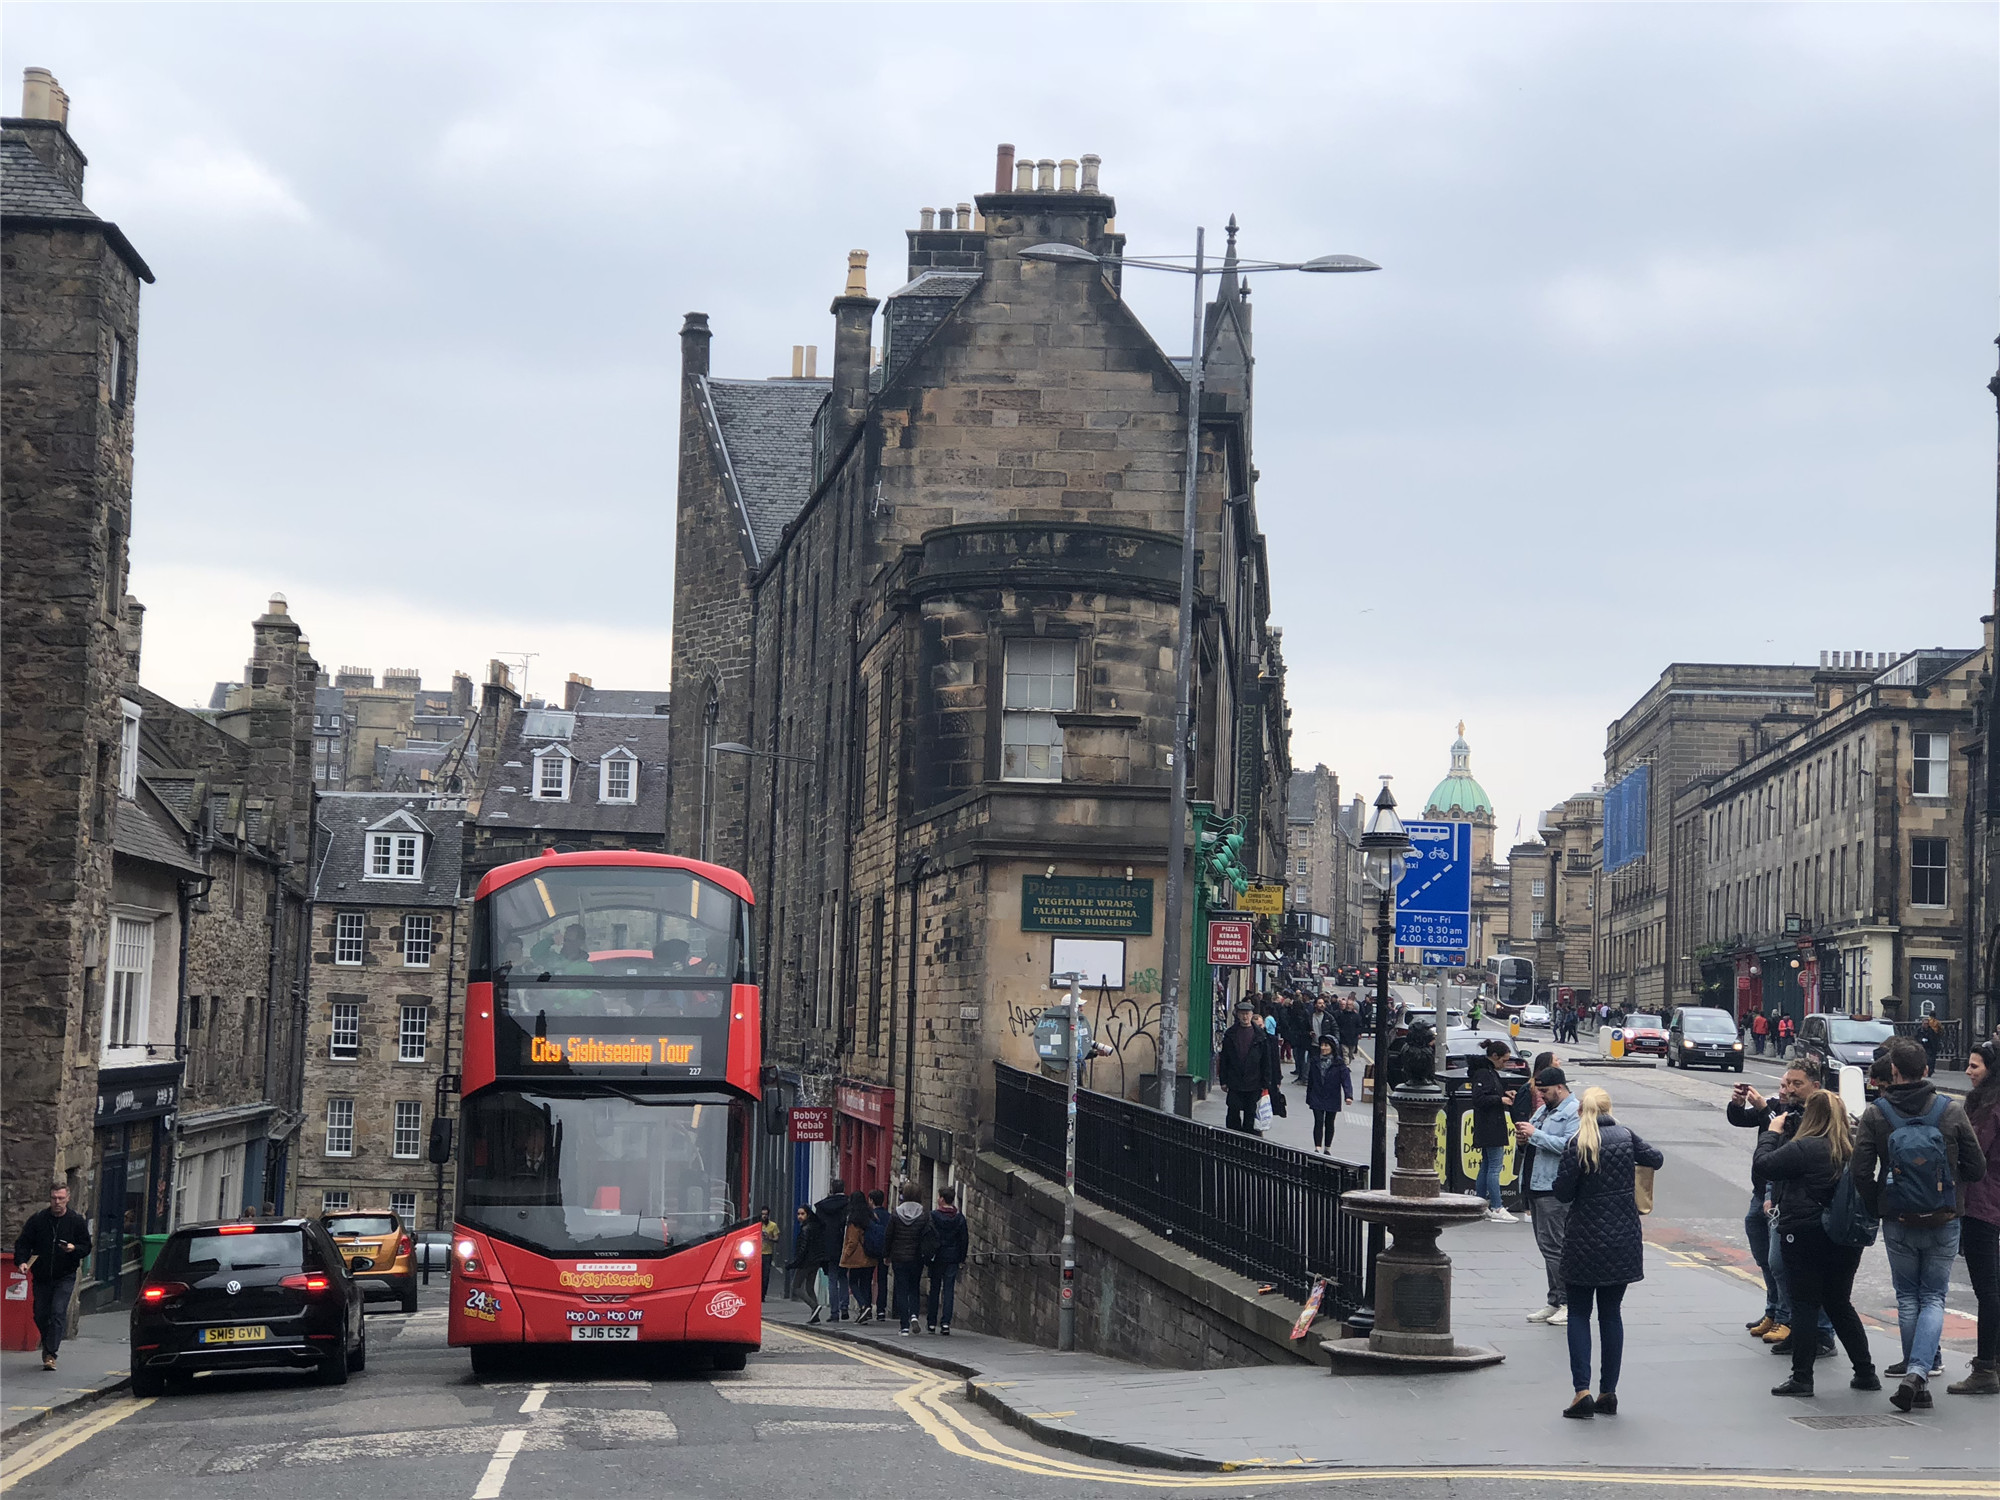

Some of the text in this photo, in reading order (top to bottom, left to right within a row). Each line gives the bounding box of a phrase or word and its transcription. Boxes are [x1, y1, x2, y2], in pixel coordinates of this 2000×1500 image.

[1240, 704, 1256, 820] FRANKENSTEIN
[1028, 882, 1149, 898] Pizza Paradise
[1037, 897, 1094, 907] VEGETABLE
[1085, 918, 1132, 927] BURGERS
[1414, 915, 1433, 924] Mon
[1440, 915, 1451, 924] Fri
[1401, 925, 1422, 934] 7.30
[1427, 926, 1448, 935] 9.30
[1400, 934, 1422, 943] 4.00
[1428, 935, 1449, 944] 6.30
[1449, 937, 1463, 945] pm
[532, 1037, 694, 1063] City Sightseeing Tour
[793, 1111, 827, 1121] Bobby's
[797, 1121, 824, 1129] Kebab
[797, 1131, 824, 1139] House
[466, 1289, 485, 1309] 24
[711, 1299, 743, 1311] OFFICIAL
[566, 1311, 585, 1321] Hop
[587, 1311, 600, 1321] On
[607, 1311, 626, 1321] Hop
[628, 1310, 643, 1321] Off
[209, 1326, 261, 1340] SM19 GVN
[579, 1328, 630, 1338] SJ16 CSZ
